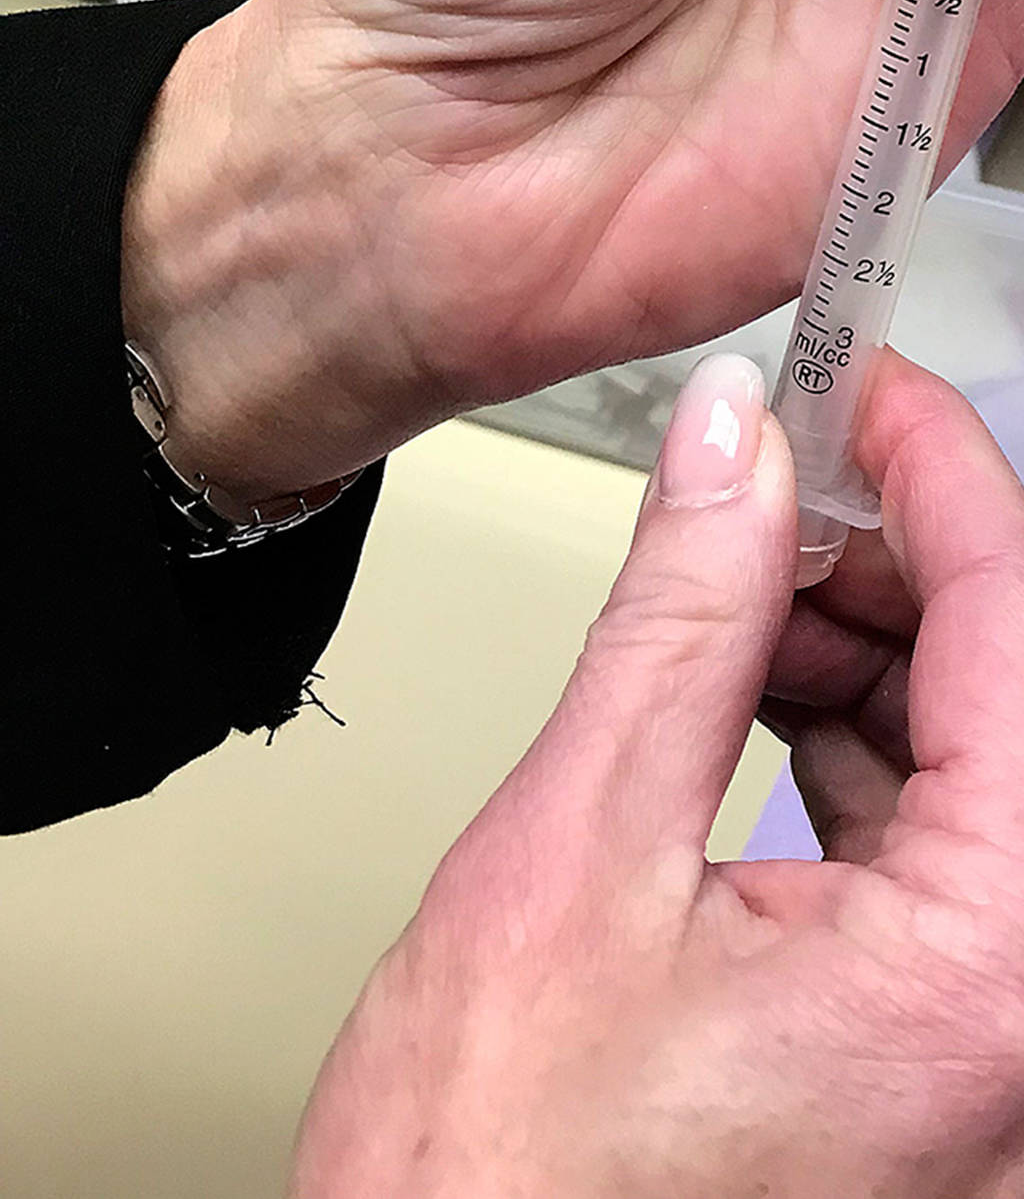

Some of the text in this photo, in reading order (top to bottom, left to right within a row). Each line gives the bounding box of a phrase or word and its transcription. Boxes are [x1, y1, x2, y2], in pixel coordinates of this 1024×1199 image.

[917, 53, 929, 76] 1
[873, 191, 895, 216] 2
[795, 331, 850, 368] ml/cc
[835, 326, 854, 349] 3
[798, 362, 827, 390] RT
